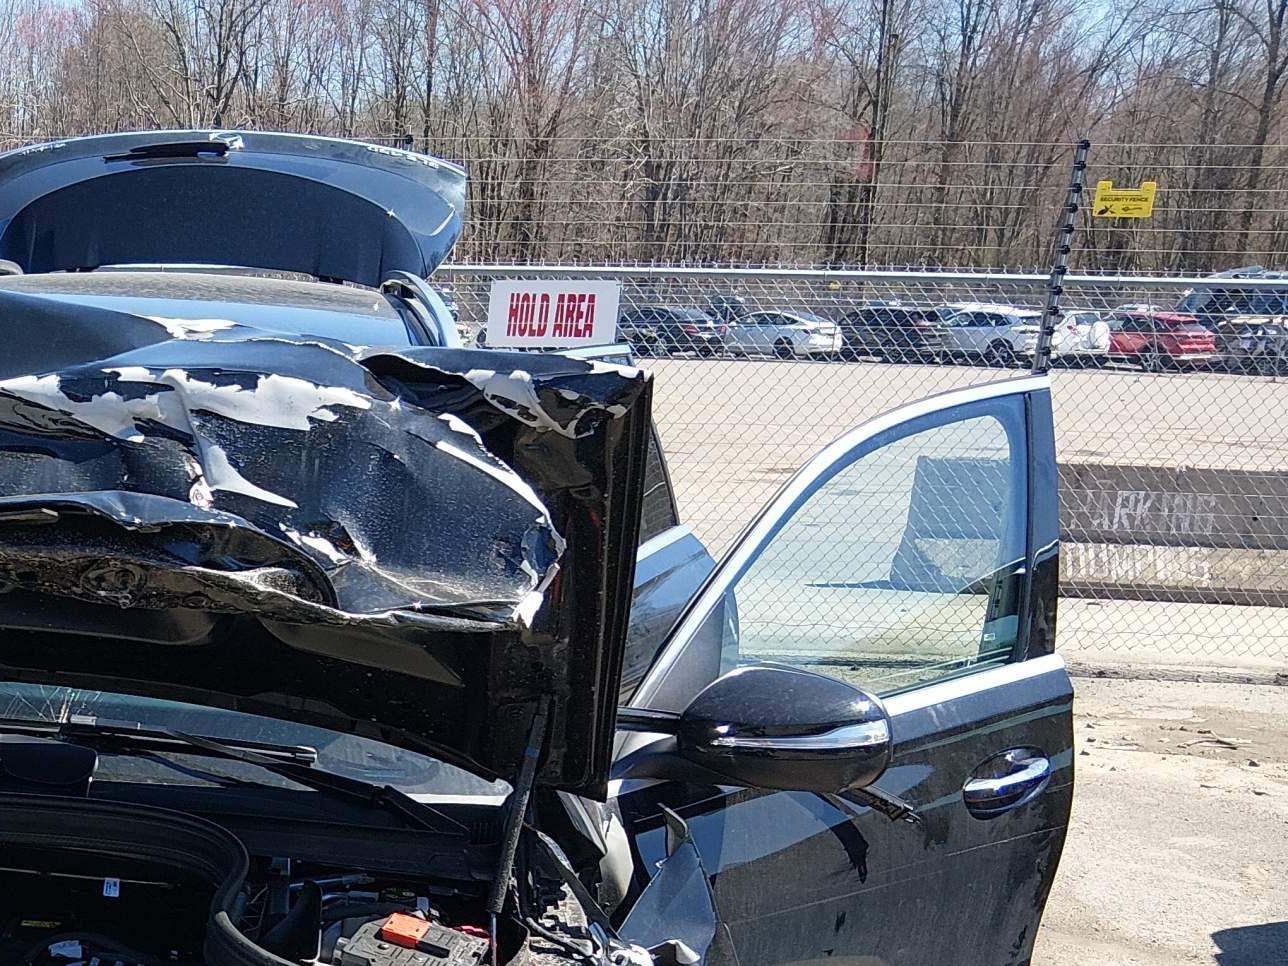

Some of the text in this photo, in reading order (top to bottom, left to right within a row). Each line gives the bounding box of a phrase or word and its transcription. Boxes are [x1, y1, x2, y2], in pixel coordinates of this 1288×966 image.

[507, 293, 596, 338] HOLD AREA
[1069, 489, 1216, 536] ARKING
